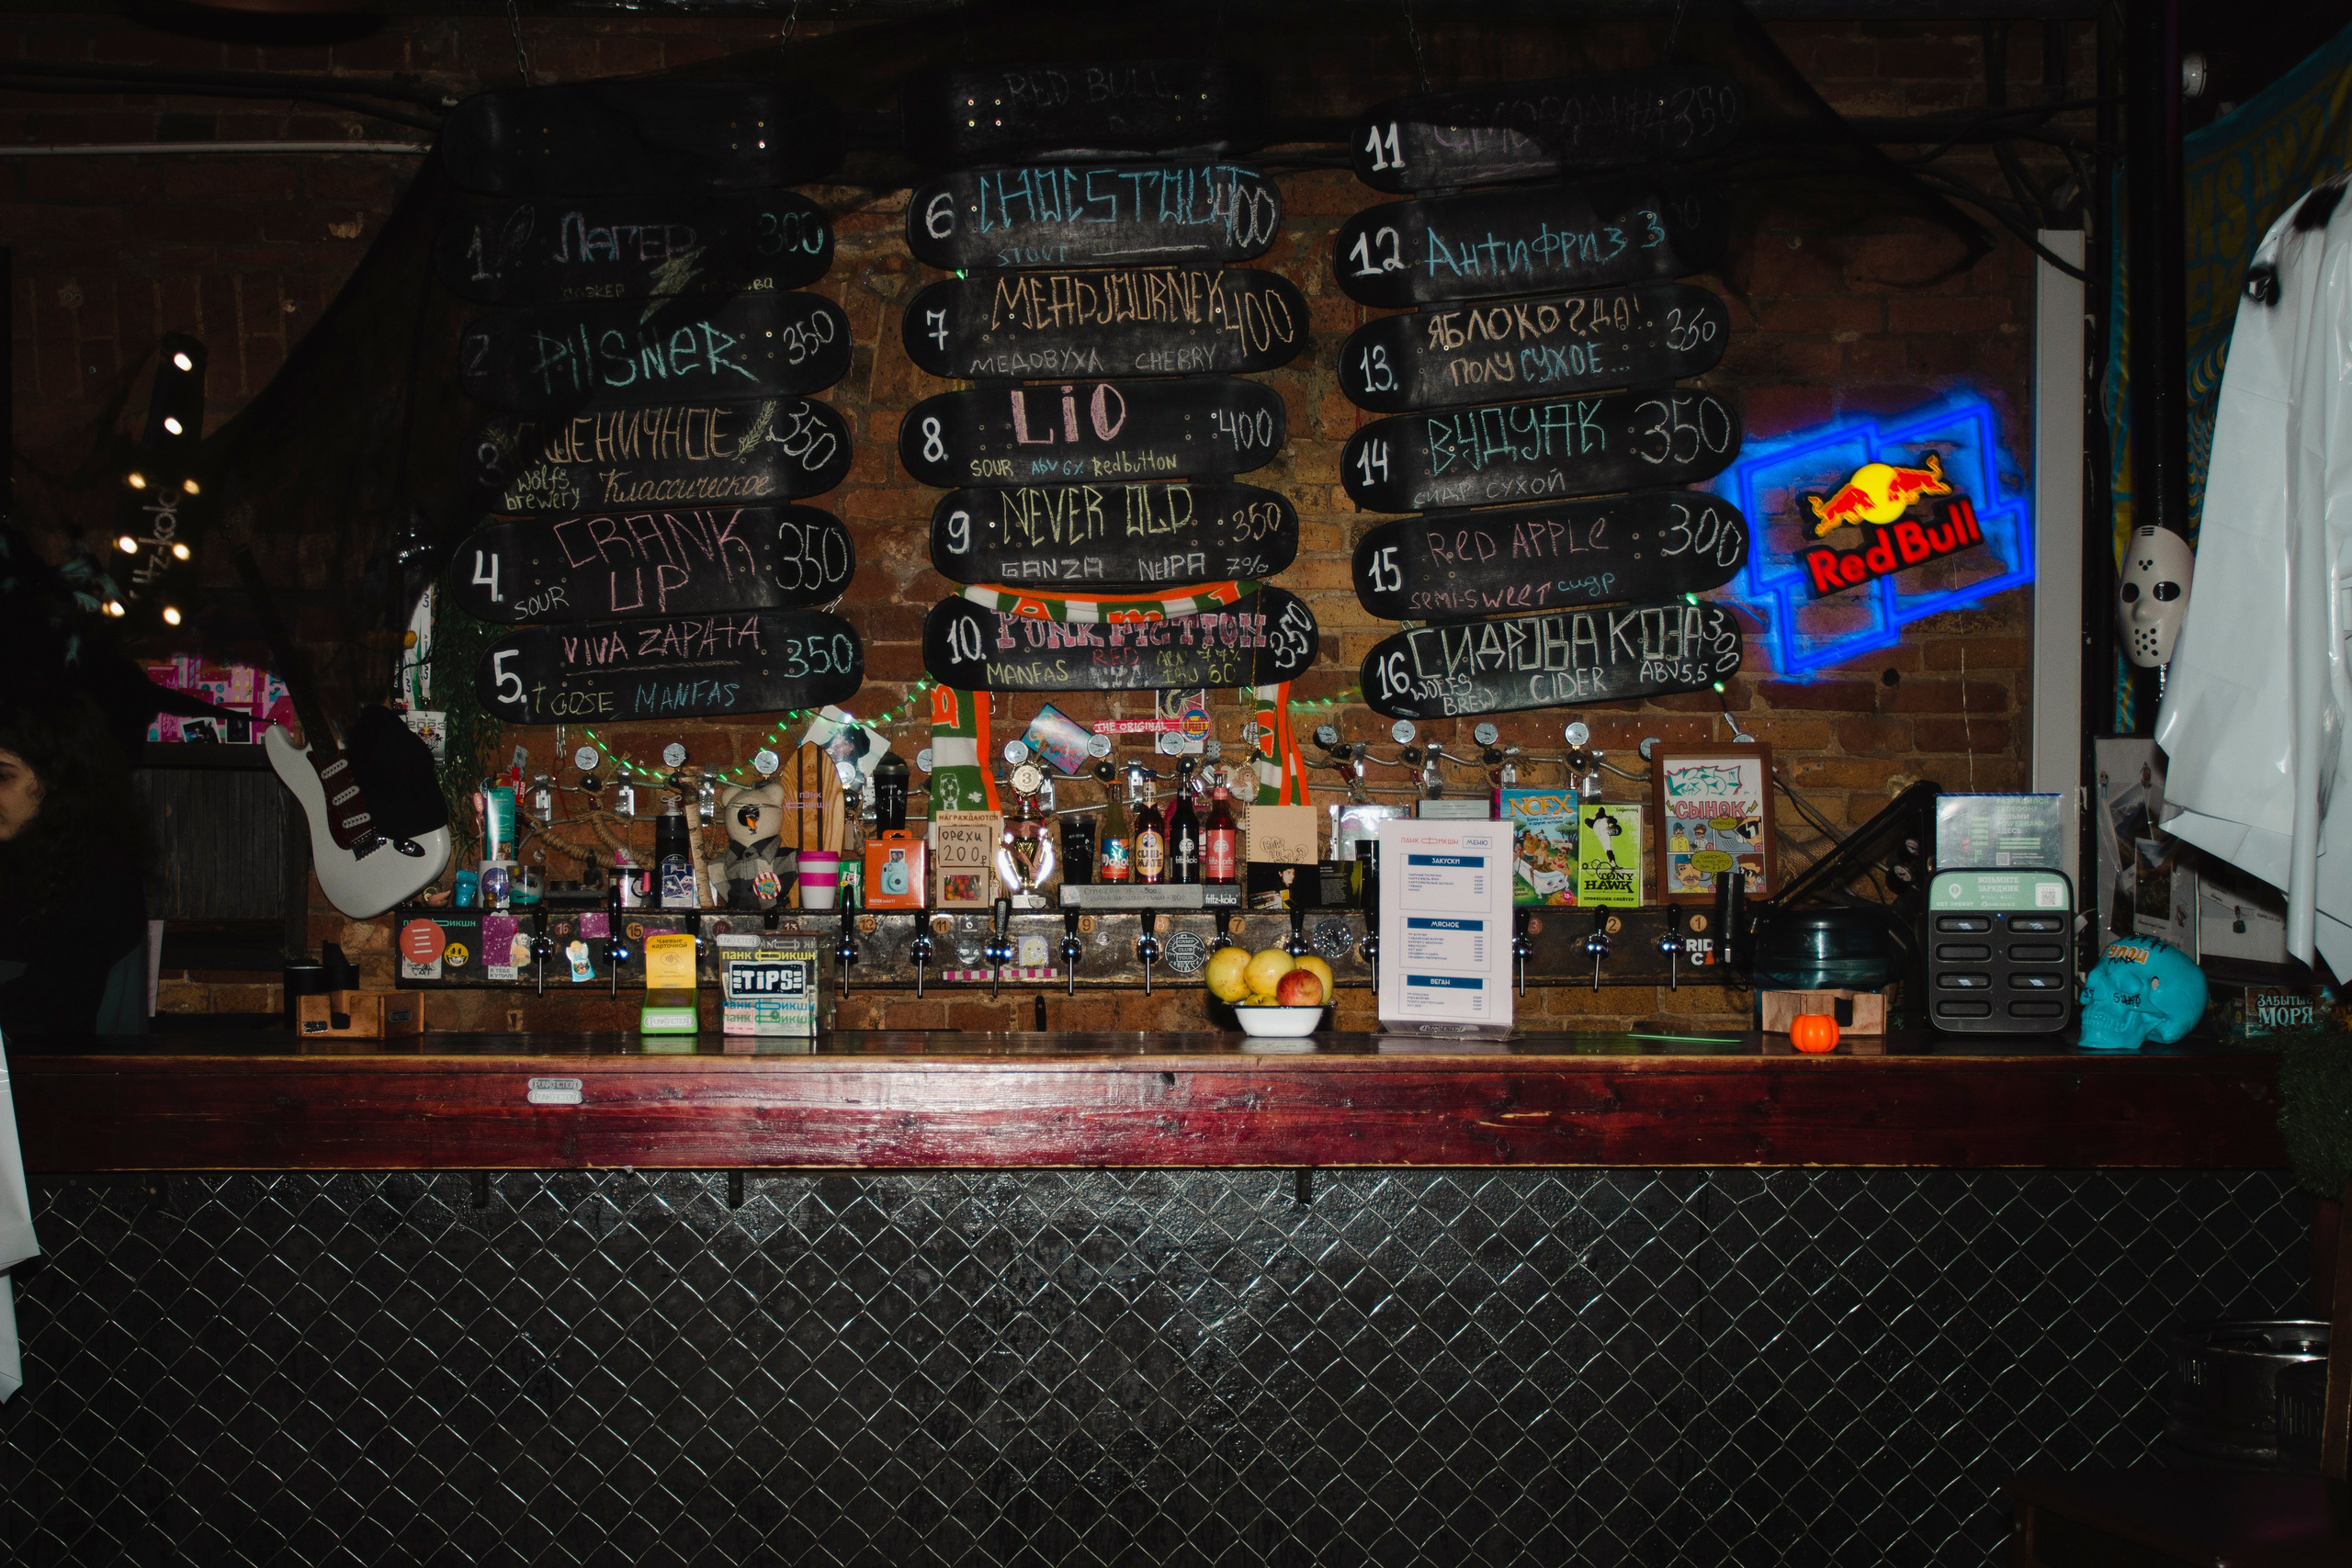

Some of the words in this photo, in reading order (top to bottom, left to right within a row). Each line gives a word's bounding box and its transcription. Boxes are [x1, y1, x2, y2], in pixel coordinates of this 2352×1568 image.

[1365, 120, 1406, 172] 11
[924, 192, 956, 240] 6
[552, 210, 696, 264] ЛАГЕР
[756, 210, 824, 255] 300
[997, 244, 1069, 266] STOUT
[926, 309, 949, 351] 7
[1221, 288, 1295, 357] 400
[1666, 308, 1716, 351] 350
[467, 333, 489, 378] 2
[783, 310, 835, 366] 350
[1135, 343, 1218, 371] CHERRY
[770, 401, 837, 470] 350
[1217, 407, 1273, 452] 400
[1356, 438, 1388, 487] 14
[1634, 396, 1732, 464] 350
[969, 458, 1013, 478] SOUR
[598, 468, 776, 504] Классическое
[946, 510, 970, 555] 9
[1000, 485, 1103, 547] NEVER
[1125, 484, 1193, 537] OLD
[1231, 502, 1282, 543] 350
[553, 509, 756, 583] CRANK
[775, 522, 848, 591] 350
[1367, 547, 1401, 592] 15
[1660, 503, 1743, 568] 300
[1806, 526, 1898, 594] Red
[1893, 497, 1982, 567] Bull
[1001, 558, 1103, 580] GANZA
[1138, 553, 1206, 582] NEIPA
[1226, 558, 1270, 576] 7%
[514, 586, 570, 620] SOUR
[611, 564, 689, 613] UP
[990, 610, 1103, 649] PUNK
[1272, 601, 1312, 669] 350
[562, 631, 629, 664] VIVA
[784, 633, 854, 679] 350
[1093, 649, 1141, 667] RED
[1375, 651, 1411, 701] 16
[1407, 612, 1600, 680] СИДРОВА
[1702, 608, 1740, 672] 300
[986, 660, 1069, 685] MANFAS
[1530, 666, 1610, 705] CIDER
[1638, 660, 1679, 682] ABV
[551, 691, 615, 716] GOSE
[635, 679, 741, 713] MANFAS
[1094, 723, 1116, 733] THE
[1119, 721, 1167, 732] ORIGINAL
[1508, 794, 1573, 818] NOFX
[1675, 800, 1747, 819] СЫНОК
[1421, 837, 1459, 845] ФИКШН
[1137, 859, 1161, 868] MATE
[1584, 880, 1634, 893] HAWK
[1978, 885, 2019, 893] ЗАРЯДНИК
[556, 923, 569, 934] 16
[628, 925, 642, 937] 15
[862, 919, 874, 931] 12
[936, 919, 947, 932] 11
[1081, 919, 1091, 931] 9
[1156, 919, 1165, 931] 8
[1233, 919, 1242, 931] 7
[1608, 919, 1616, 931] 2
[1695, 918, 1702, 930] 1
[722, 952, 752, 960] панк
[722, 1001, 751, 1010] панк
[2256, 994, 2313, 1007] ЗАБЫТЫЕ
[722, 1014, 751, 1022] панк
[2258, 1007, 2313, 1028] МОРЯ
